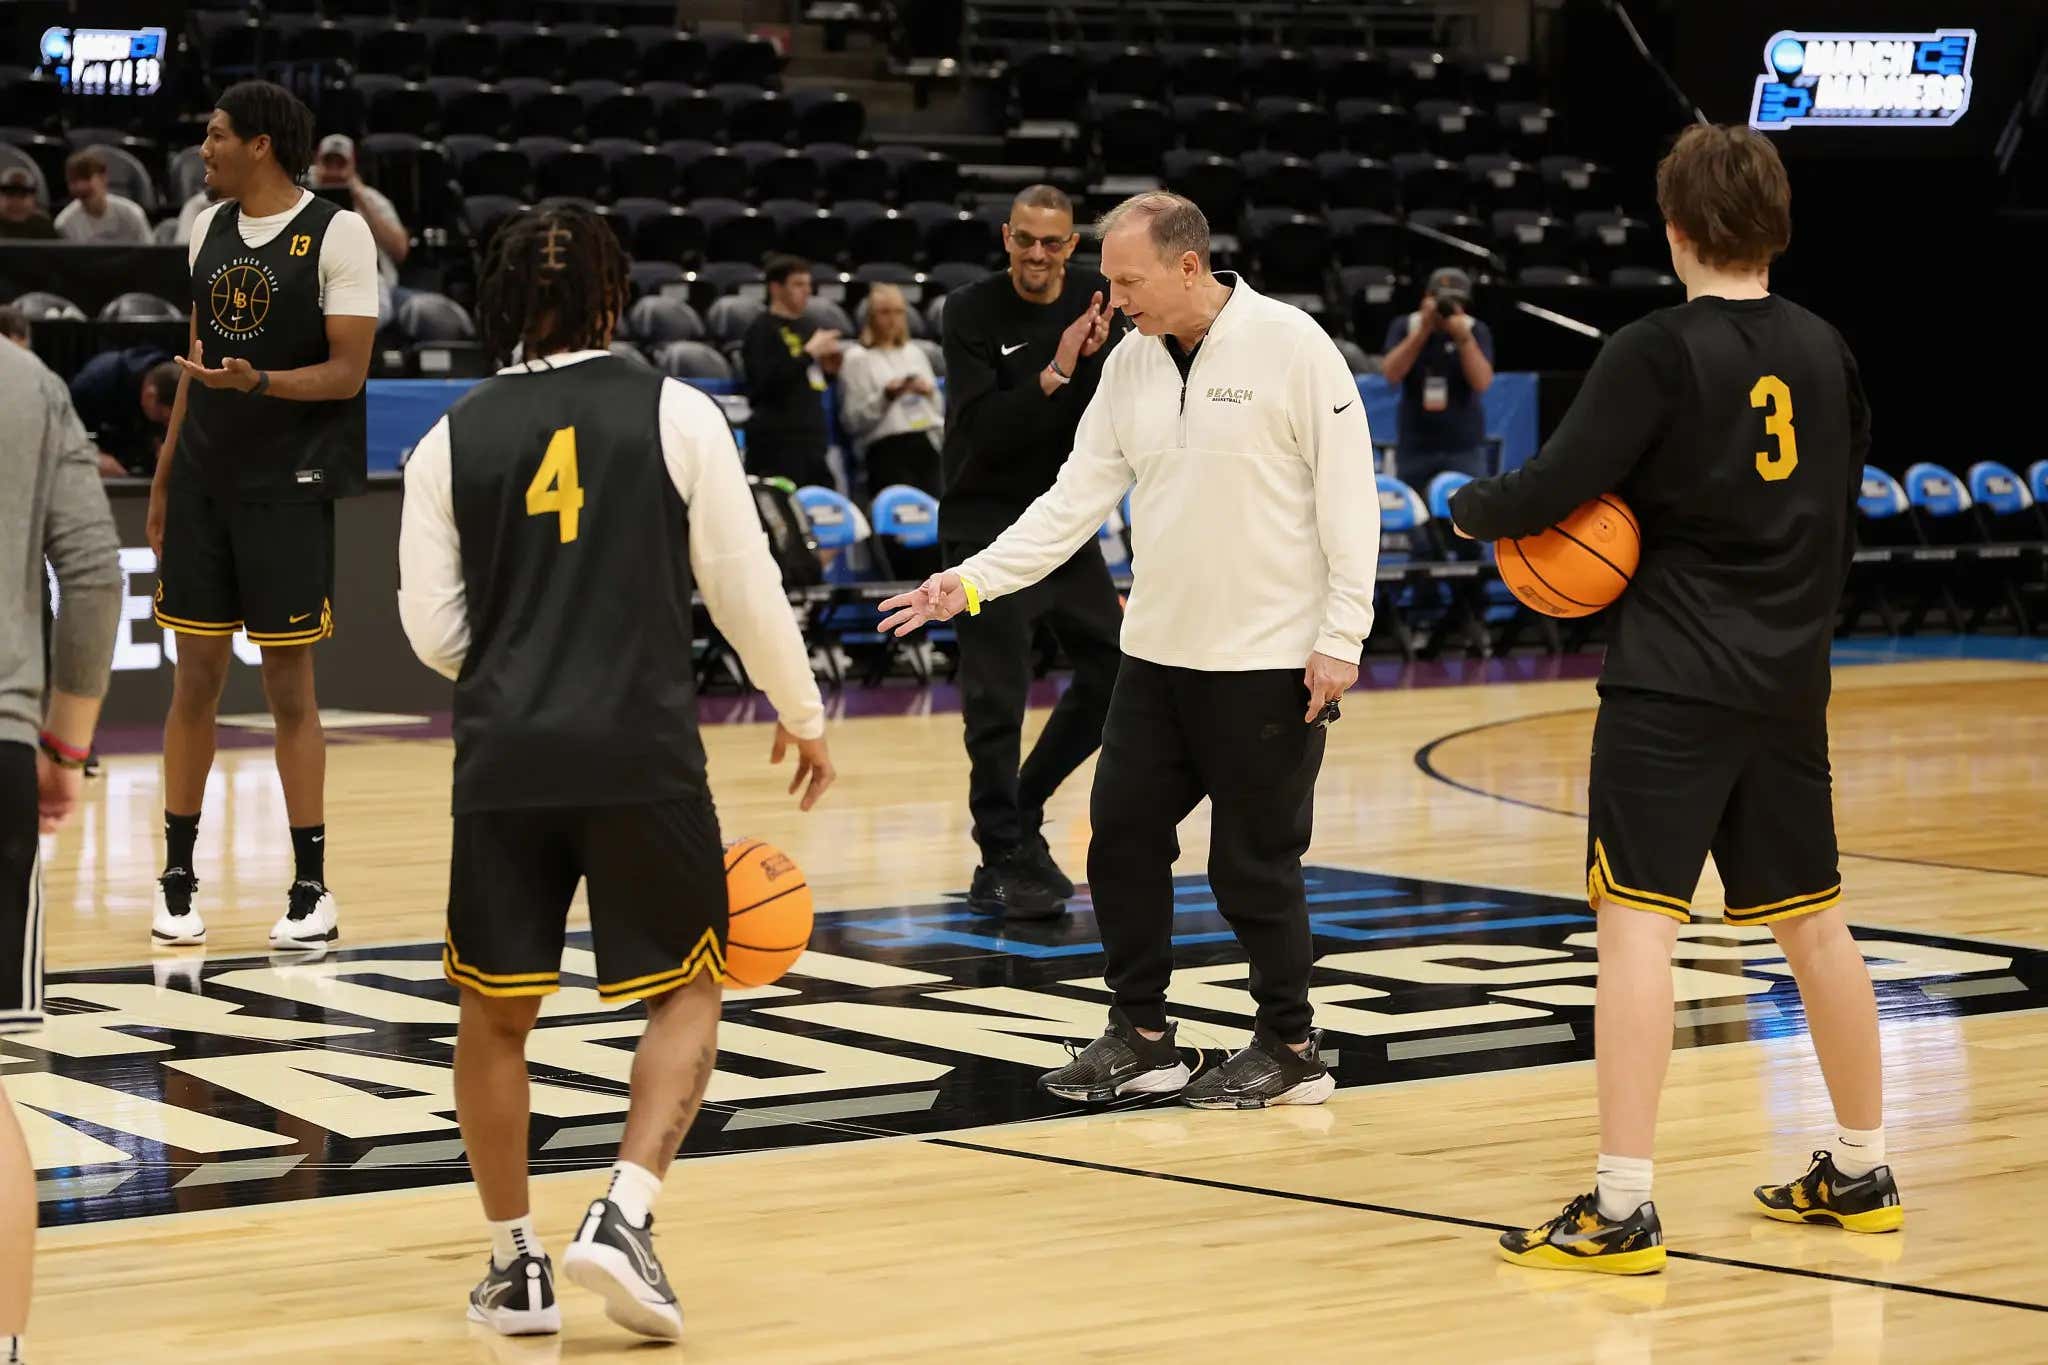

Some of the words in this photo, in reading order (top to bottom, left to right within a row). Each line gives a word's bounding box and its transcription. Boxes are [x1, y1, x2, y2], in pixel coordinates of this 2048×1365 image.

[289, 234, 312, 256] 13
[233, 257, 260, 266] BEACH
[262, 265, 280, 292] STATE
[210, 319, 265, 341] BASKETBALL
[1749, 374, 1798, 482] 3
[525, 425, 584, 543] 4
